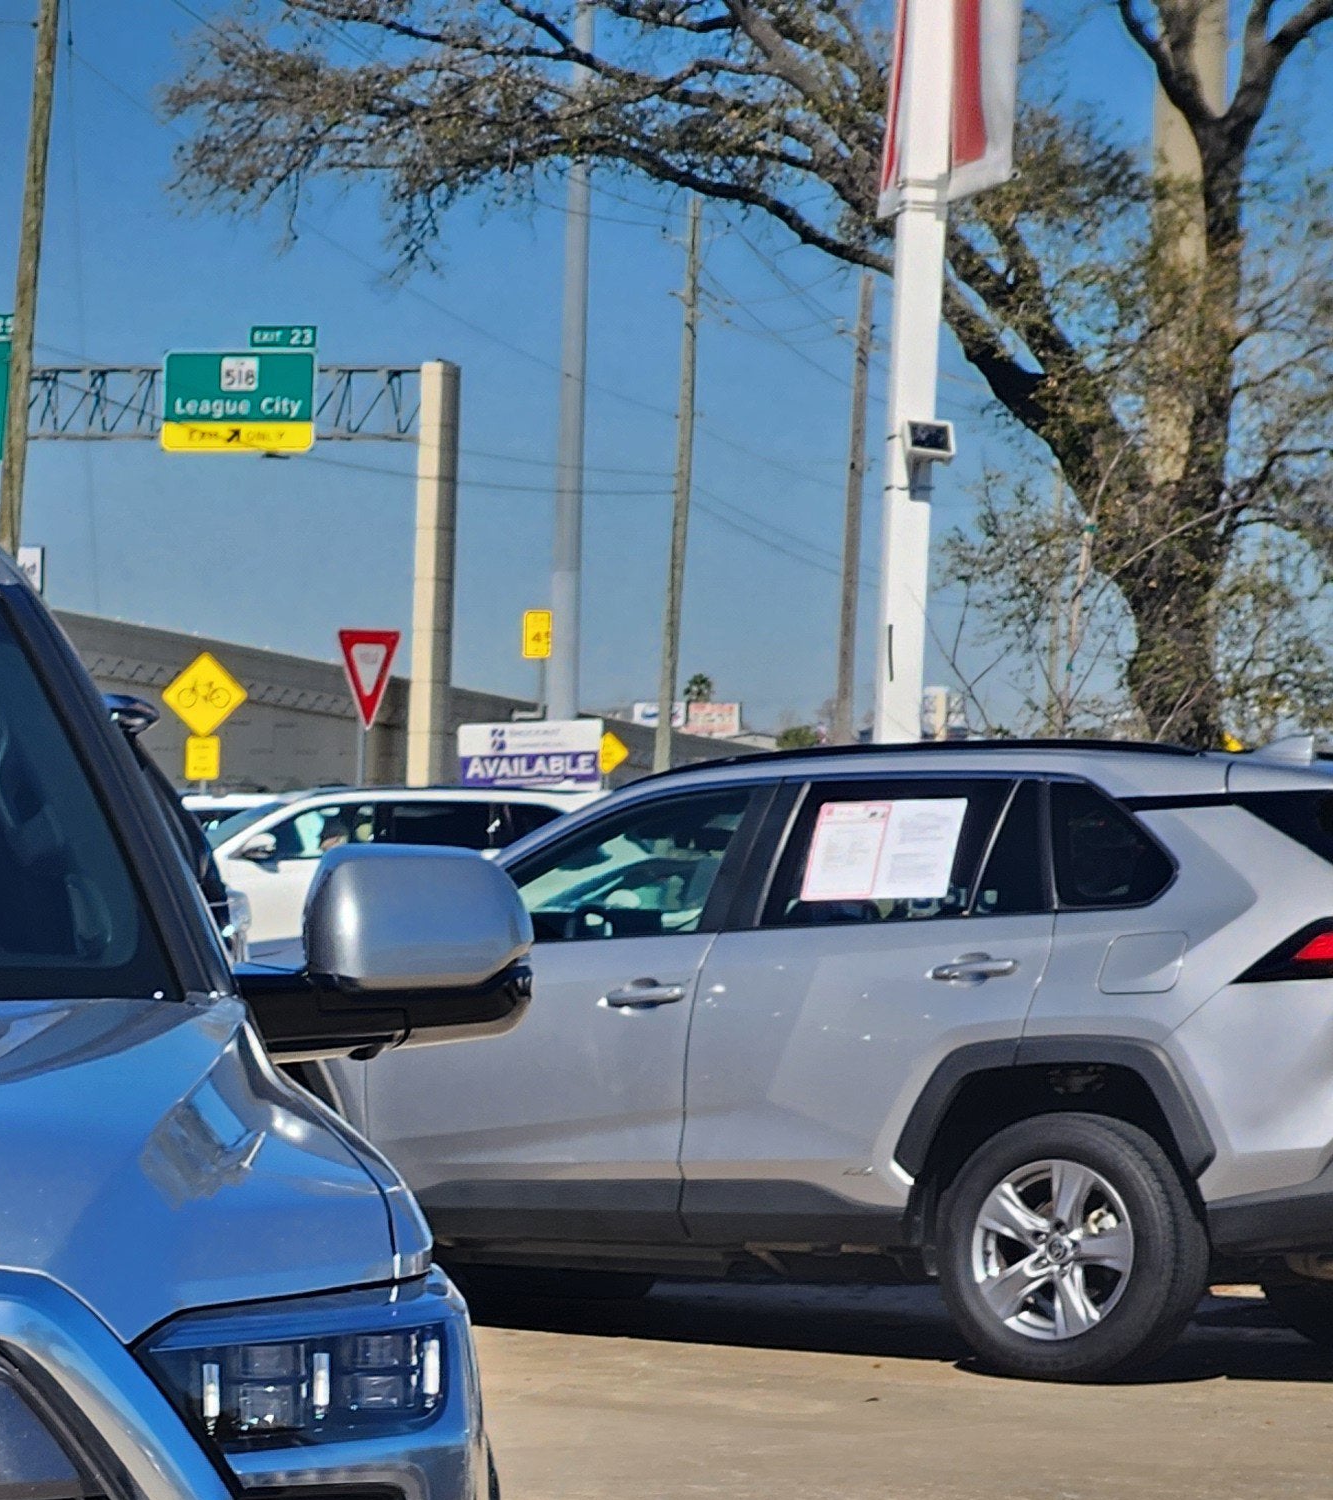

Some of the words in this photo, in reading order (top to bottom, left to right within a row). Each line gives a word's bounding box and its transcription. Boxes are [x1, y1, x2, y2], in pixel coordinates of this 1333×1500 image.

[252, 330, 282, 342] EXIT
[289, 328, 313, 345] 23
[225, 369, 255, 386] 518
[174, 397, 251, 418] League
[260, 396, 303, 418] City
[465, 754, 596, 780] AVAILABLE
